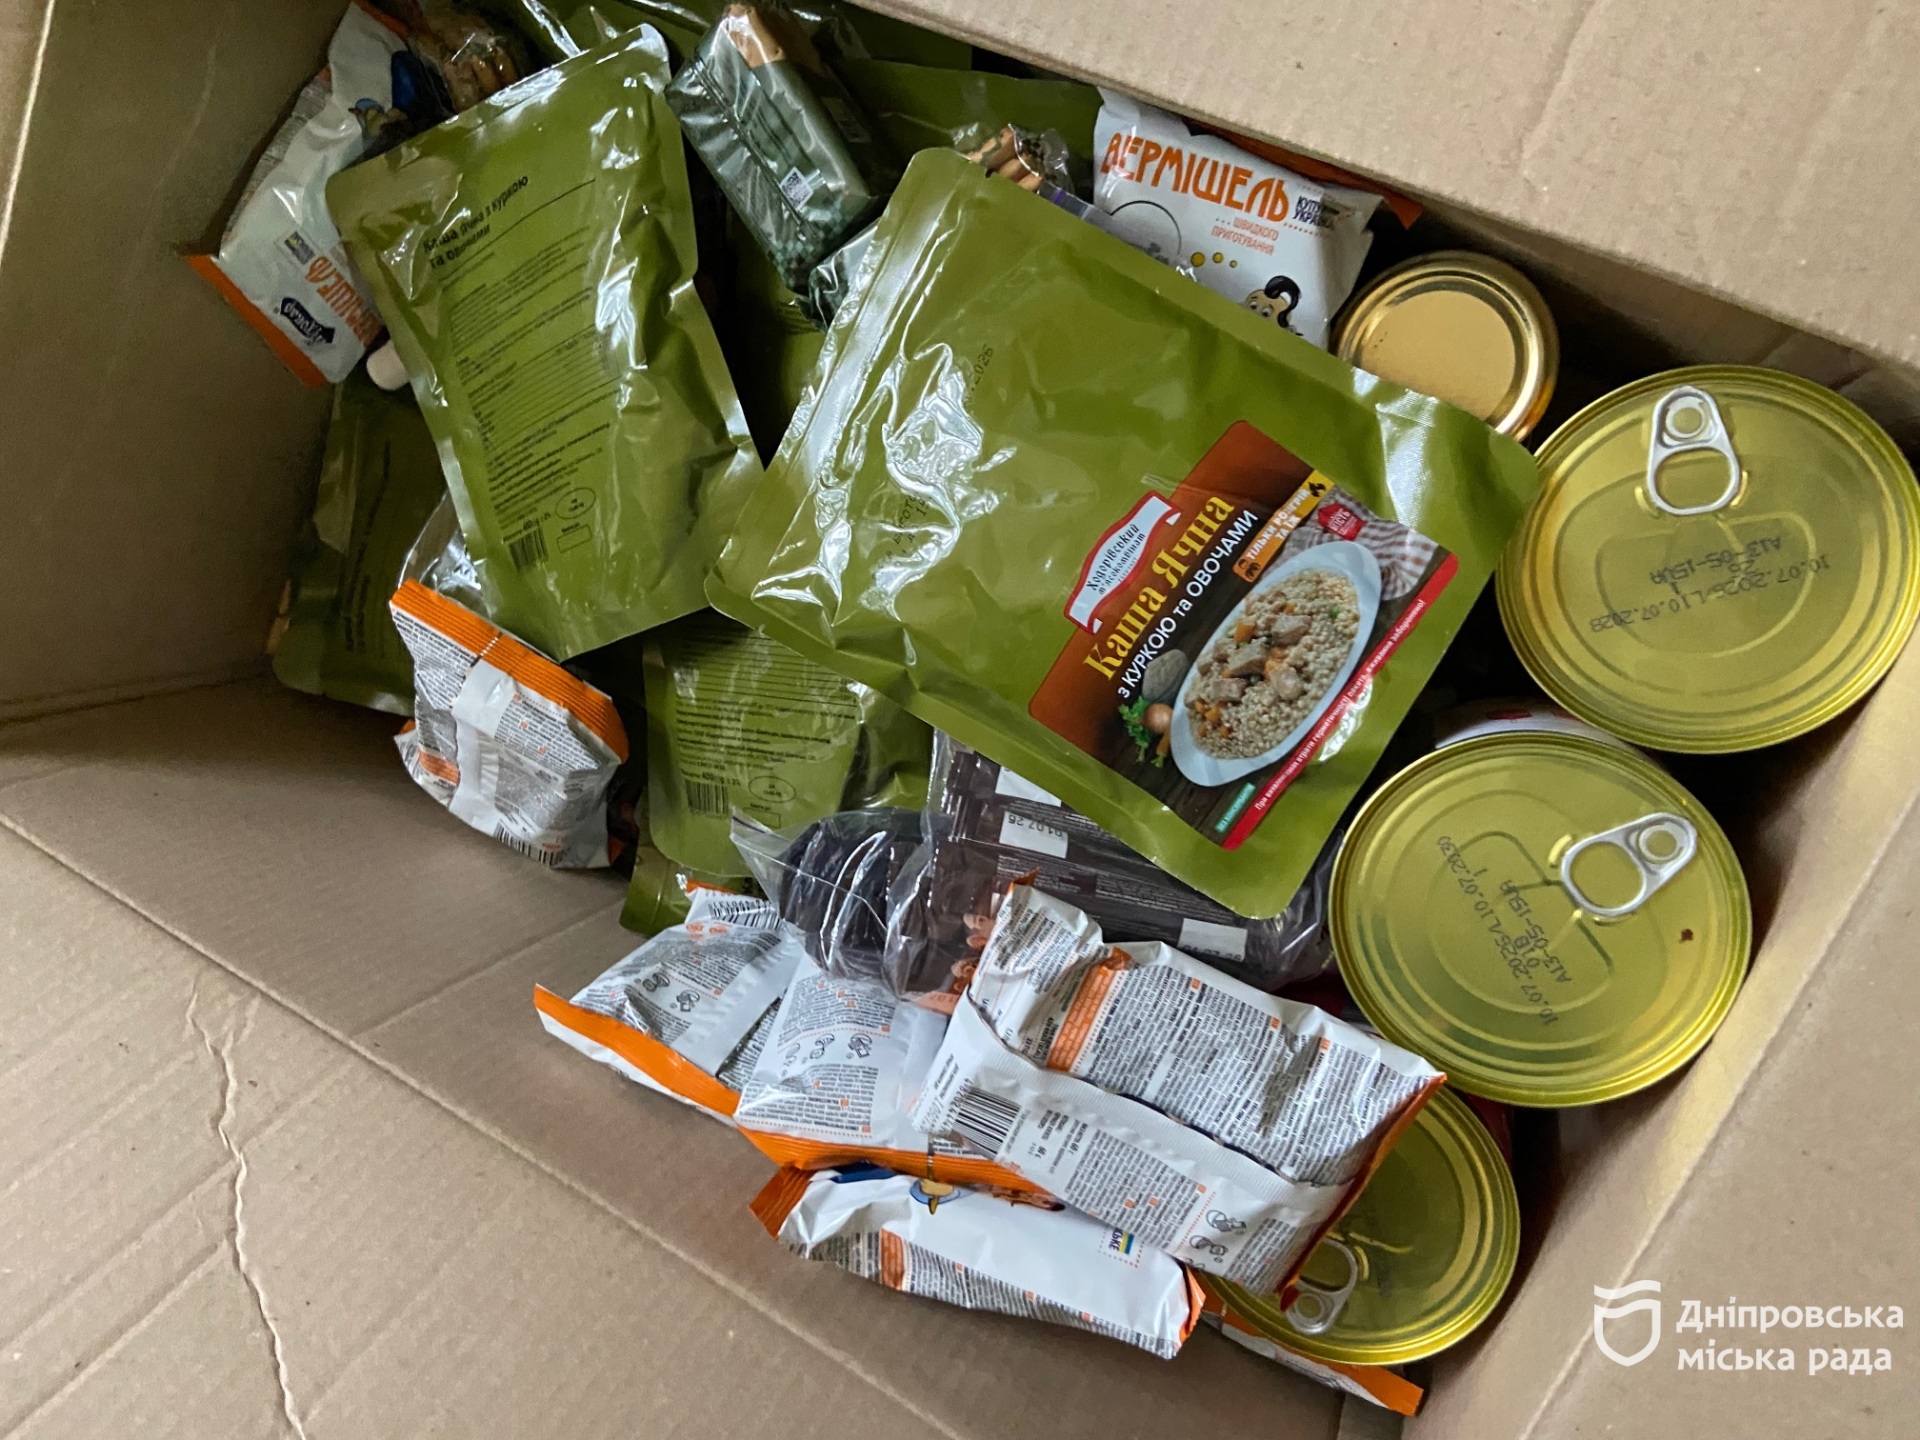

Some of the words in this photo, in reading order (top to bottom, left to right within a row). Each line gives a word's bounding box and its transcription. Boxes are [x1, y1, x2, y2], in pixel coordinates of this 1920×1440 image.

[490, 175, 530, 211] куркою
[428, 254, 444, 269] та
[1246, 525, 1277, 559] ТІЛЬКИ
[1275, 526, 1290, 541] ТА
[1084, 522, 1140, 590] Ходорівський
[1184, 508, 1258, 599] ОВОЧАМИ
[1082, 583, 1168, 681] Каша
[1147, 493, 1235, 589] Ячна
[1172, 596, 1194, 620] та
[1121, 614, 1179, 687] КУРКОЮ
[1117, 685, 1131, 698] з
[1254, 795, 1268, 811] При
[1295, 740, 1316, 762] втрати
[1311, 695, 1351, 742] герметичності
[1389, 598, 1426, 642] заборонено!
